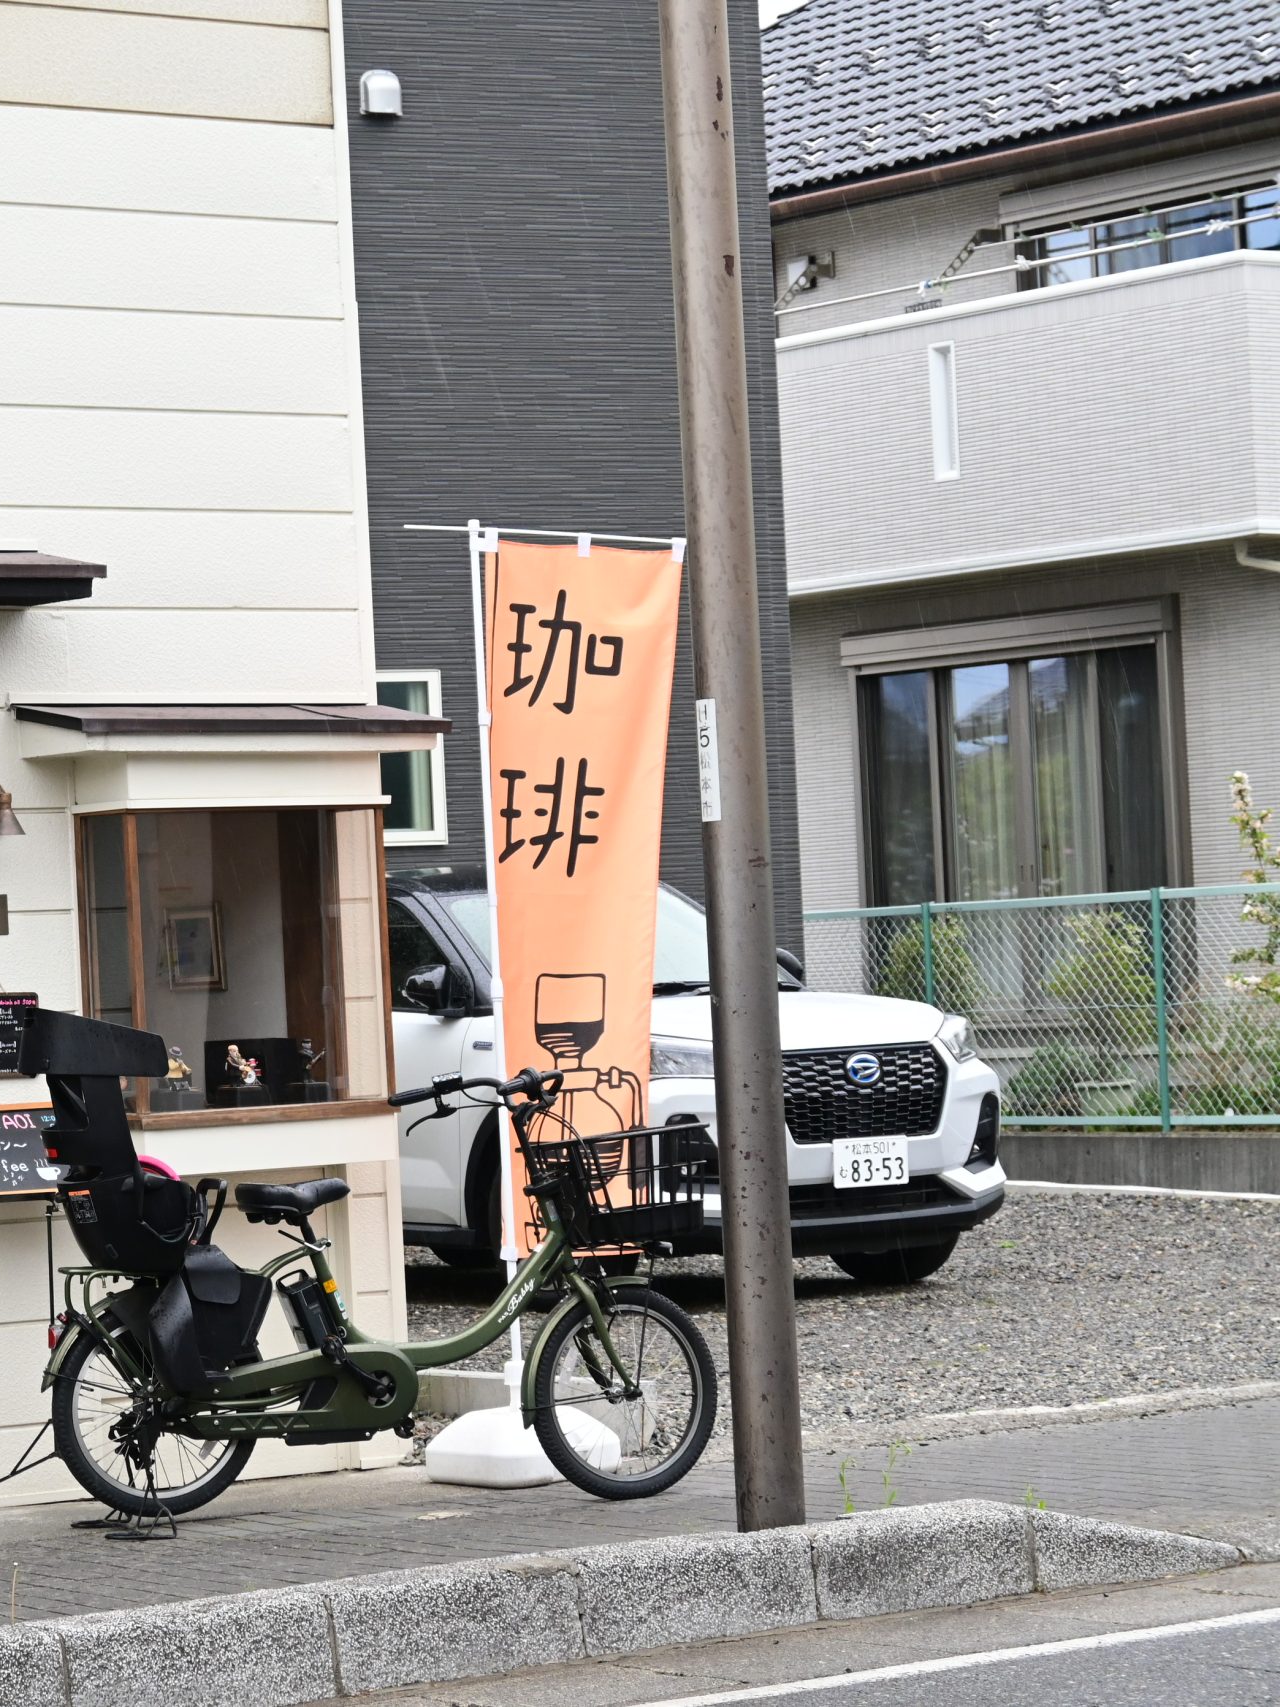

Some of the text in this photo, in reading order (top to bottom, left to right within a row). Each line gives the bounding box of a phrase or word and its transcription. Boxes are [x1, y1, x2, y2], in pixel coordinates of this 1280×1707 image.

[499, 589, 624, 878] 珈琲
[2, 1114, 37, 1129] AOI
[851, 1157, 904, 1182] 83-53
